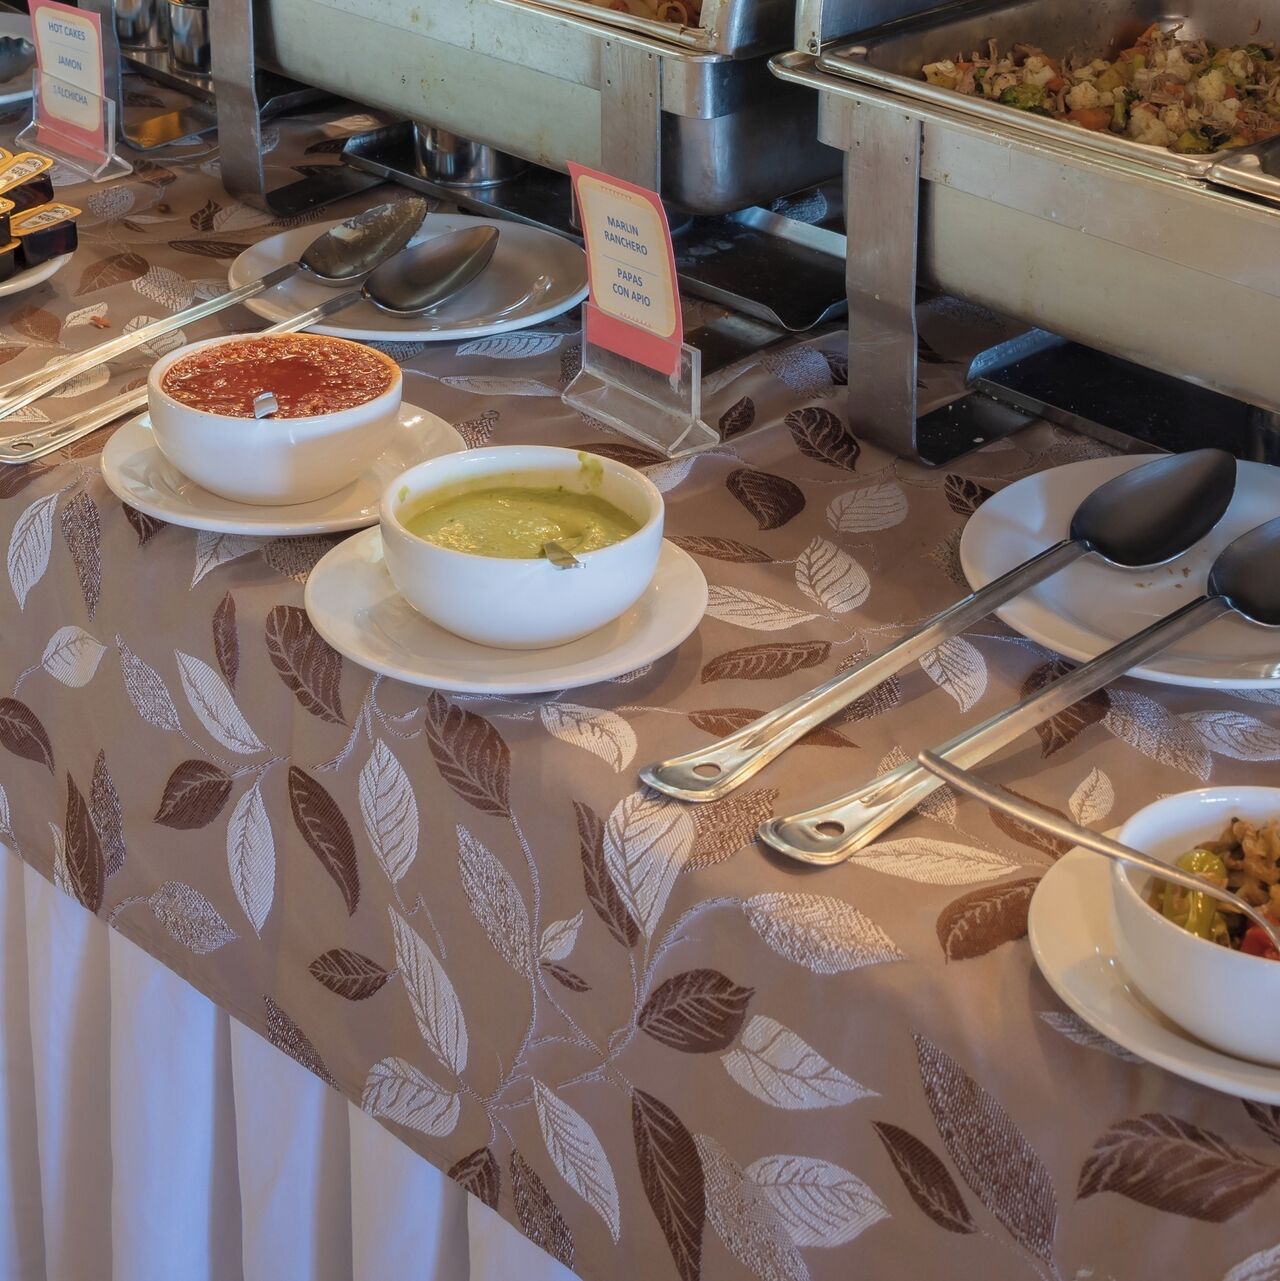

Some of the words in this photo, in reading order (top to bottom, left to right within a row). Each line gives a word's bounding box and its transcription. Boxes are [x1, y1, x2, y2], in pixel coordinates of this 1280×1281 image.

[48, 21, 64, 35] HOT
[64, 26, 86, 41] CAKES
[58, 55, 82, 71] JAMON
[607, 216, 639, 237] MARLIN
[604, 230, 648, 256] RANCHERO
[617, 268, 643, 288] PAPAS
[612, 283, 630, 299] CON
[631, 289, 651, 307] APIO
